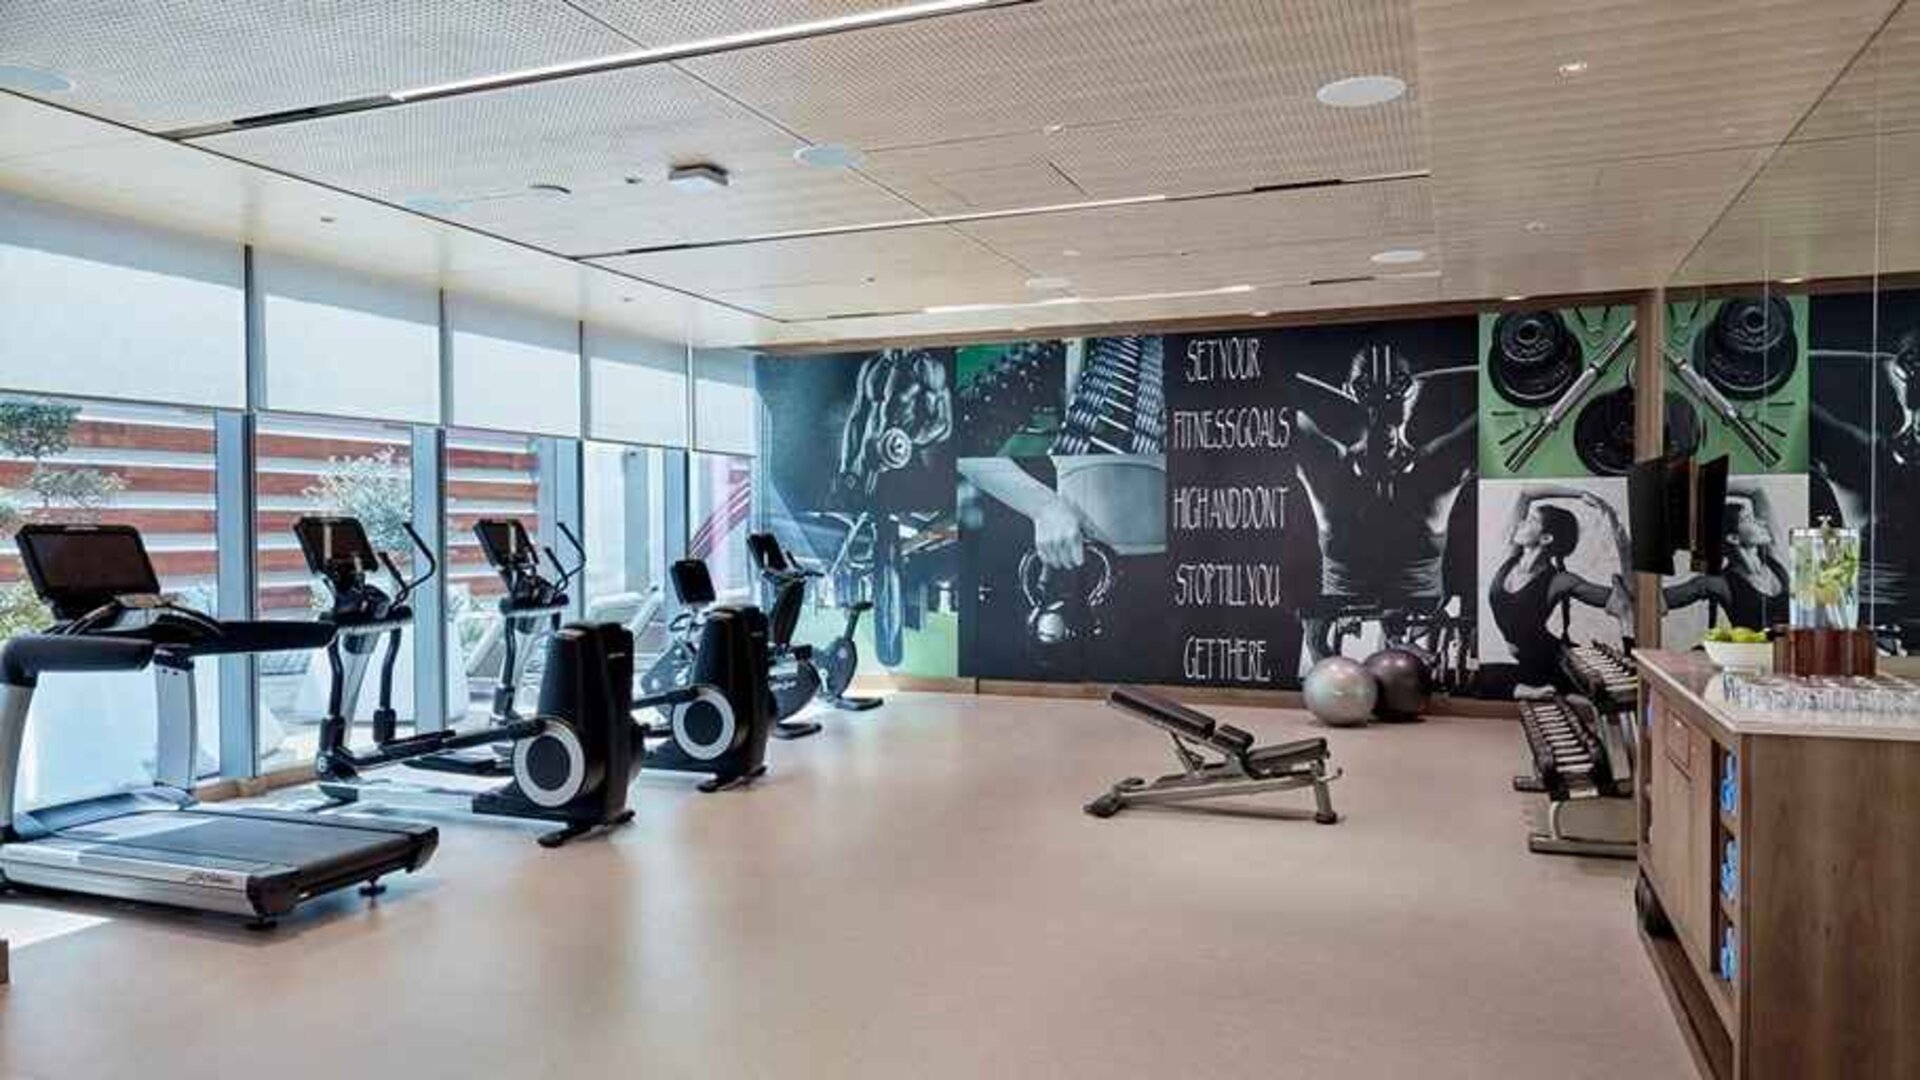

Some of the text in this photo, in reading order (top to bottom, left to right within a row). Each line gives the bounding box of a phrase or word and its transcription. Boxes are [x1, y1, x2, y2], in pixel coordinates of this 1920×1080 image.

[1185, 337, 1260, 382] SET YOUR
[1173, 407, 1290, 449] FITNESS GOALS
[1173, 486, 1208, 530] HIGH
[1209, 487, 1241, 529] AND
[1174, 563, 1280, 608] STOP TILL YOU
[1183, 636, 1216, 680] GET
